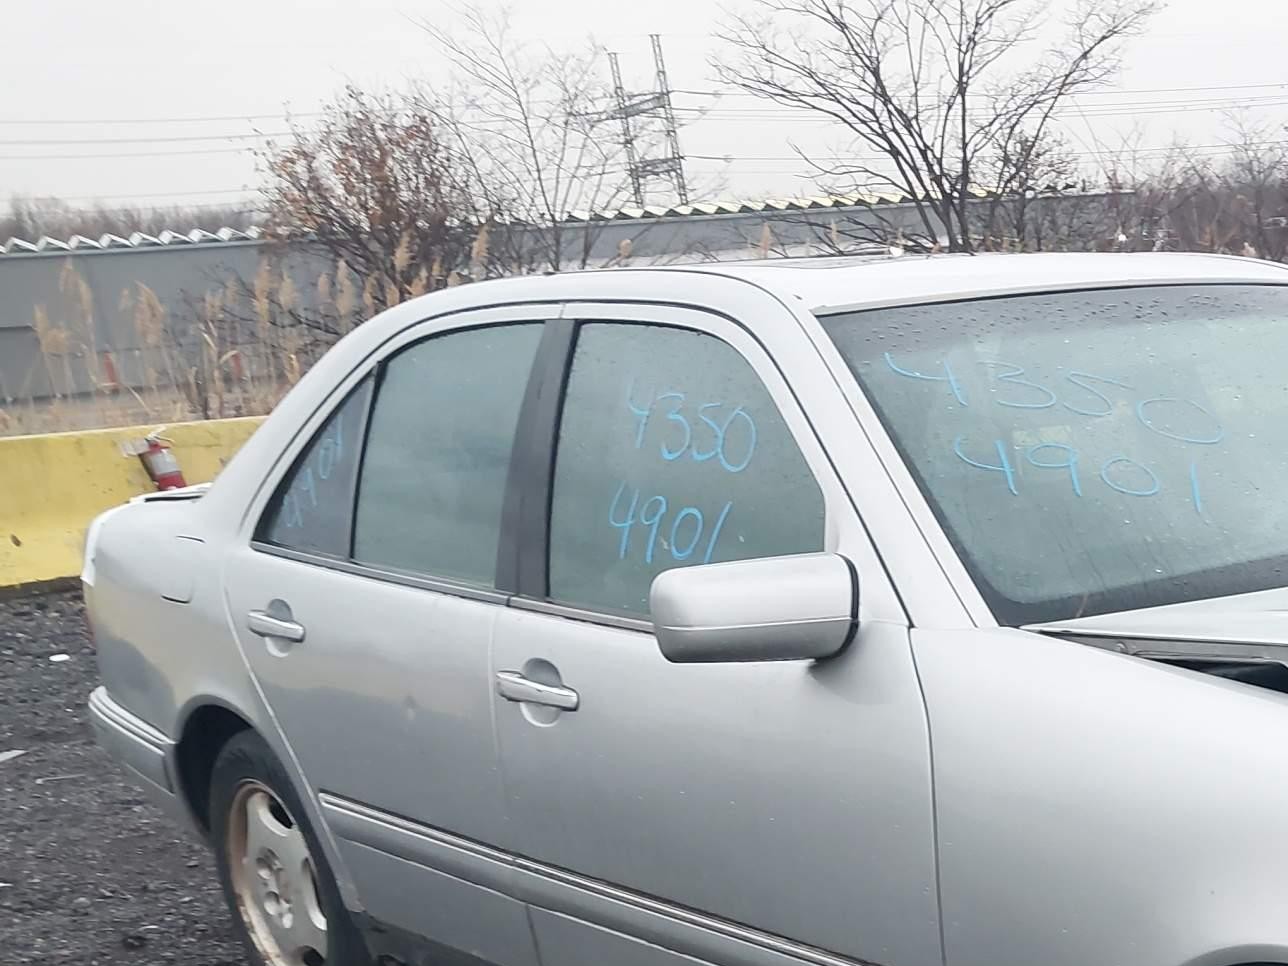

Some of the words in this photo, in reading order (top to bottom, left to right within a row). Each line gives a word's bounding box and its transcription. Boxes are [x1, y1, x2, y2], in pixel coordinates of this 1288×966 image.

[628, 384, 757, 472] 4350
[884, 351, 1223, 444] 4350
[954, 435, 1201, 513] 4901
[609, 479, 733, 564] 4901
